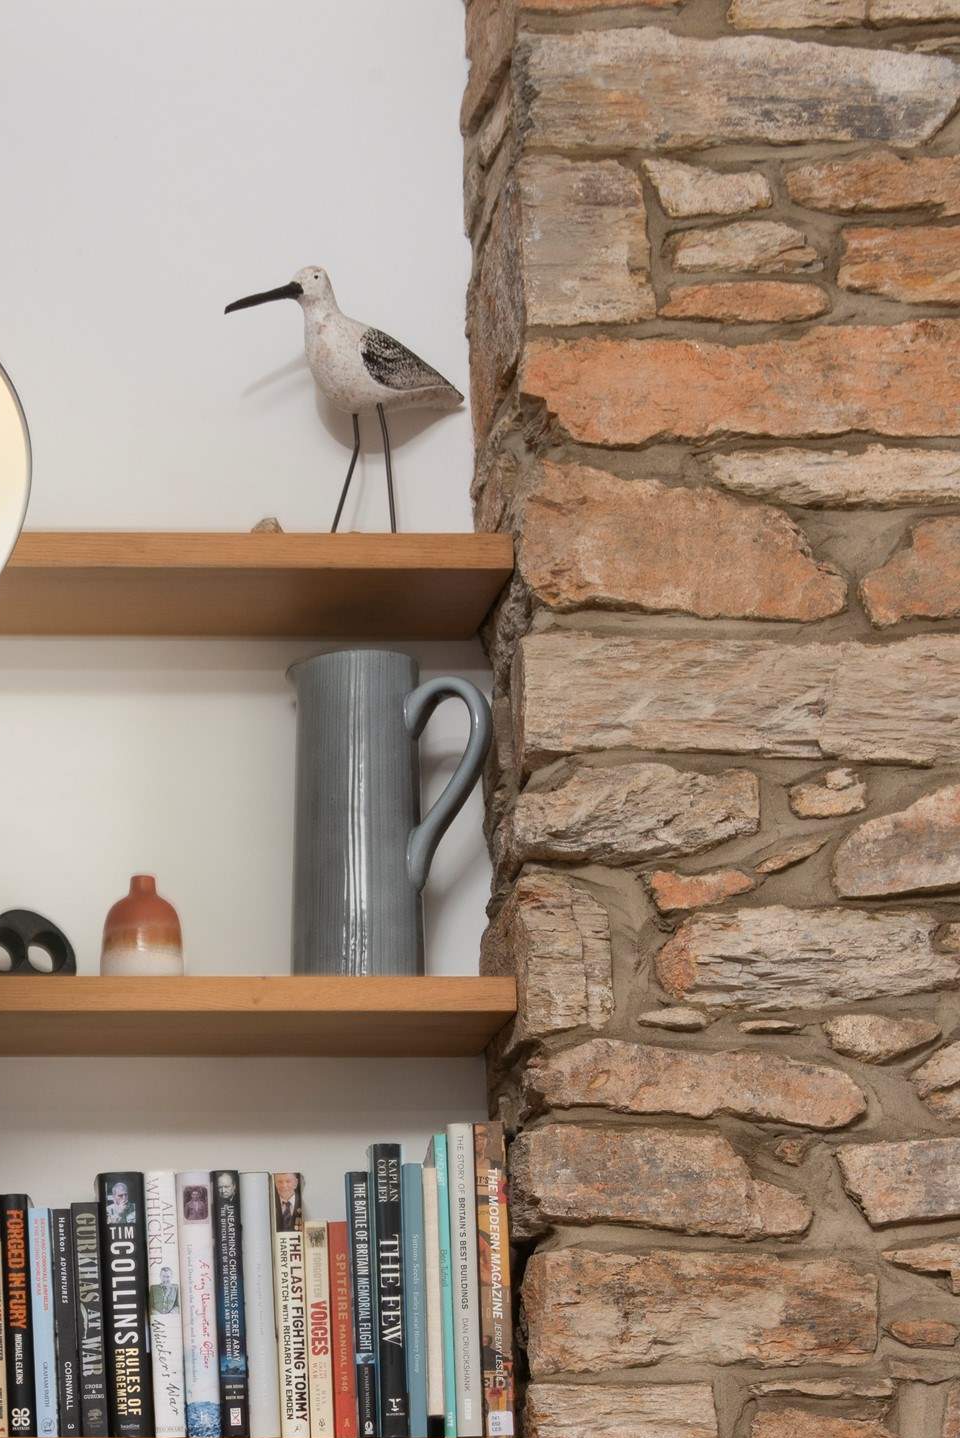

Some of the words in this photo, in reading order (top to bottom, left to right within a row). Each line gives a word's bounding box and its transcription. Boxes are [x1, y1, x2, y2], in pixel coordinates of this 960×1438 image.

[456, 1135, 464, 1151] THE
[377, 1159, 387, 1203] COLLIER
[388, 1159, 399, 1202] KAPLAN
[457, 1154, 465, 1181] STORY
[488, 1168, 498, 1193] THE
[353, 1182, 366, 1198] THE
[458, 1183, 465, 1195] OF
[109, 1226, 134, 1240] TIM
[146, 1178, 162, 1269] WHICKER
[161, 1201, 176, 1245] ALAN
[227, 1205, 236, 1257] UNEARTHING
[354, 1200, 368, 1229] BATTLE
[458, 1197, 466, 1238] BRITAIN'S
[488, 1195, 500, 1251] MODERN
[6, 1210, 25, 1268] FORGED
[58, 1217, 66, 1252] Haarkon
[279, 1238, 289, 1268] HARRY
[289, 1234, 302, 1262] THE
[356, 1230, 368, 1242] OF
[76, 1212, 100, 1303] GURKHAS
[222, 1256, 229, 1264] OF
[356, 1243, 370, 1275] BRITAIN
[379, 1233, 401, 1289] THE
[9, 1272, 26, 1287] IN
[60, 1257, 69, 1304] ADVENTURES
[110, 1241, 139, 1345] COLLINS
[229, 1258, 239, 1308] CHURCHILL'S
[281, 1271, 290, 1301] PATCH
[290, 1266, 303, 1303] LAST
[336, 1253, 349, 1321] SPITFIRE
[357, 1277, 371, 1321] MEMORIAL
[460, 1264, 469, 1310] BUILDINGS
[491, 1251, 503, 1320] MAGAZINE
[9, 1290, 27, 1329] FURY
[87, 1308, 101, 1330] AT
[231, 1309, 240, 1338] SECRET
[310, 1300, 329, 1356] VOICES
[381, 1294, 403, 1349] FEW
[461, 1317, 470, 1334] DAN
[14, 1333, 22, 1361] MICHAEL
[82, 1335, 103, 1377] WAR
[232, 1339, 241, 1361] ARMY
[283, 1325, 292, 1365] RICHARD
[292, 1306, 306, 1370] FIGHTING
[340, 1324, 348, 1367] MANUAL
[359, 1323, 373, 1351] FLIGHT
[494, 1321, 503, 1353] JEREMY
[114, 1349, 128, 1416] ENGAGEMENT
[125, 1348, 141, 1392] RULES
[340, 1371, 349, 1392] 1940
[462, 1335, 471, 1392] CRUICKSHANK
[495, 1354, 505, 1383] LESLIE
[128, 1398, 142, 1416] OF
[285, 1389, 294, 1421] EMDEN
[295, 1373, 308, 1422] TOMMY
